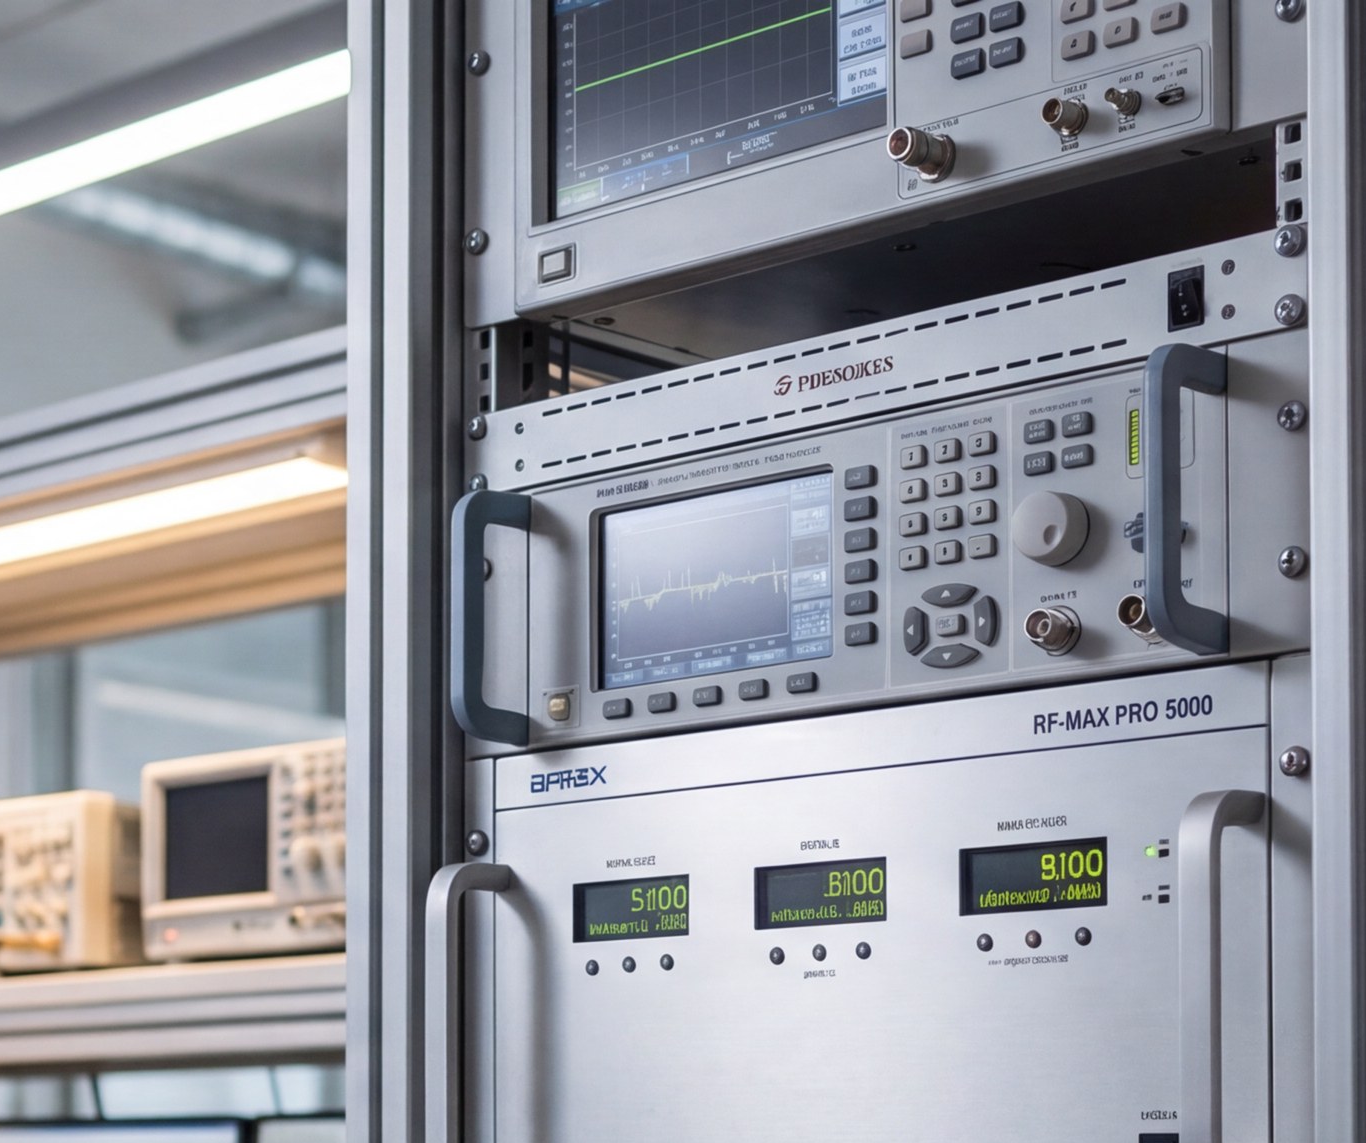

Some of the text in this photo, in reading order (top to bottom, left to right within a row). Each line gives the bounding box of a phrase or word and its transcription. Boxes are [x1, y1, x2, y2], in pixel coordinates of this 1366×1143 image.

[1033, 694, 1213, 734] RF-MAX PRO 5000
